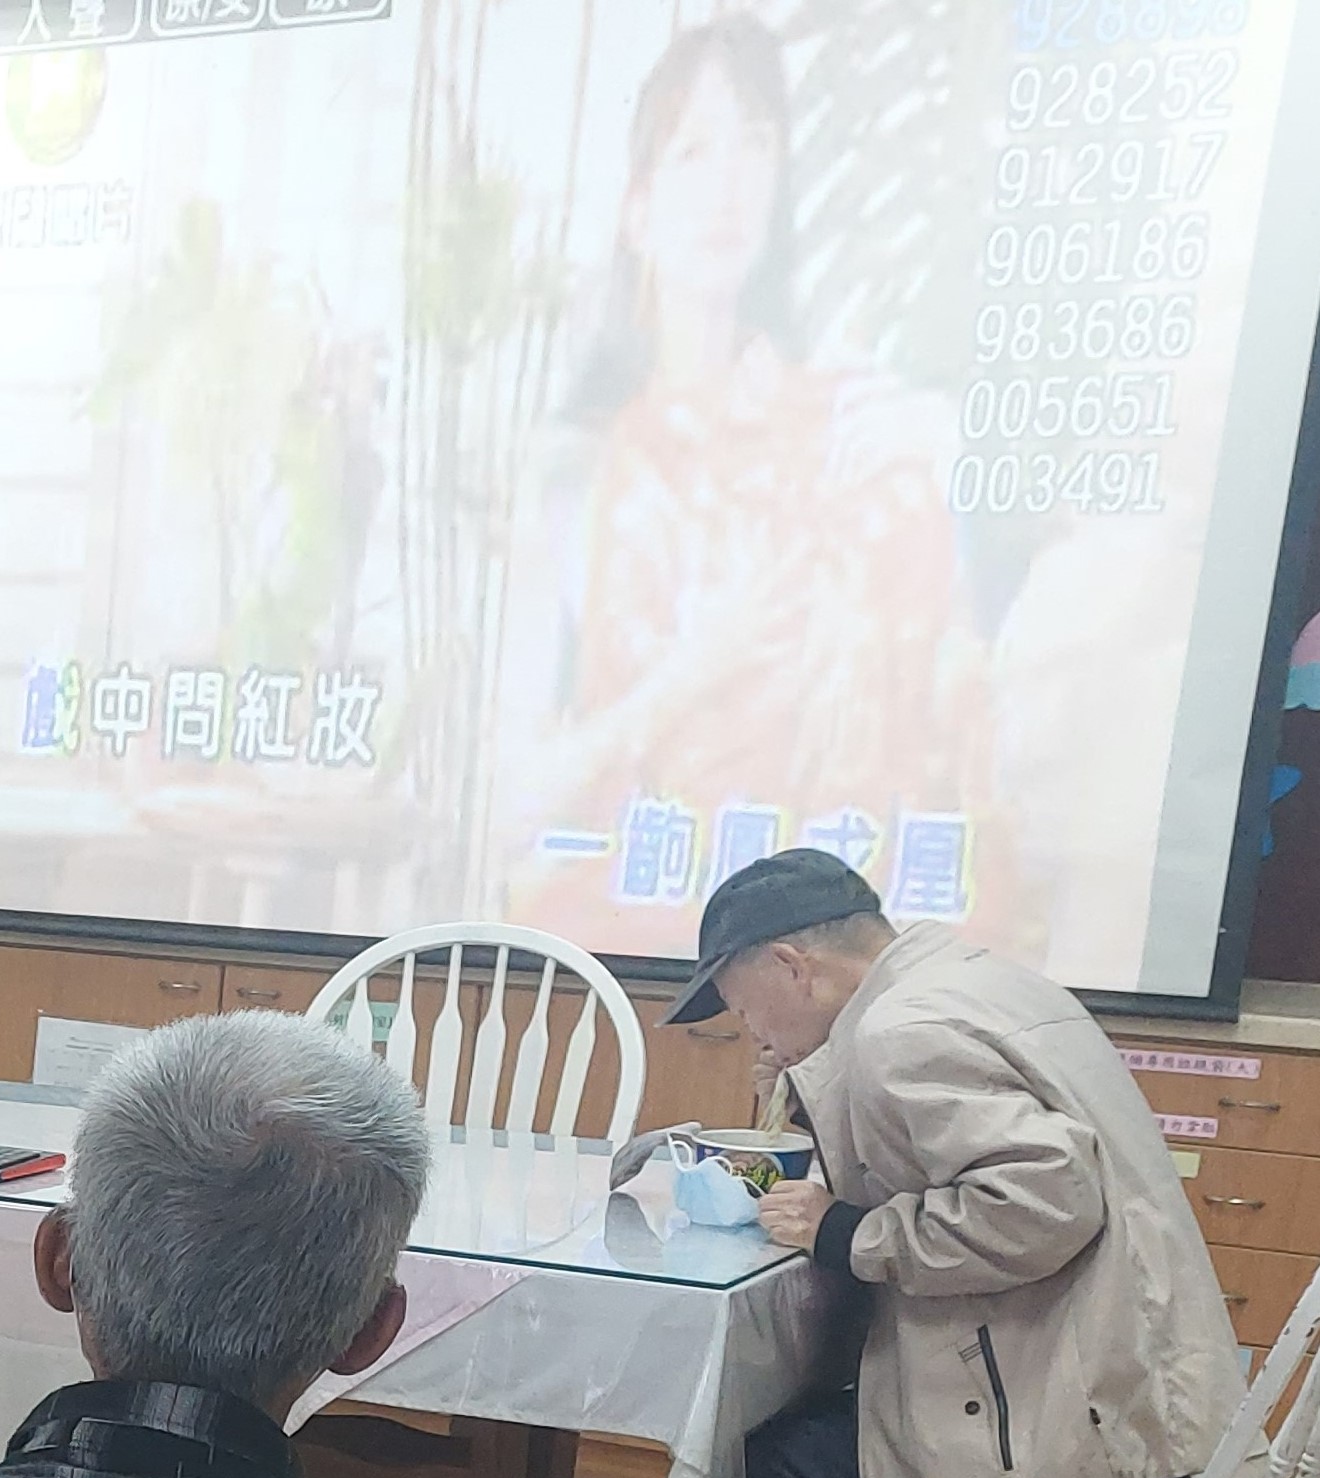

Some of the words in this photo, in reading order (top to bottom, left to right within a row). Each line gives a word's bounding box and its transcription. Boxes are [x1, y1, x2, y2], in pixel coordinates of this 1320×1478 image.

[1007, 48, 1238, 132] 928252
[996, 131, 1227, 209] 912917
[985, 212, 1207, 287] 906186
[975, 294, 1196, 364] 983686
[962, 373, 1178, 440] 005651
[951, 450, 1166, 514] 003491
